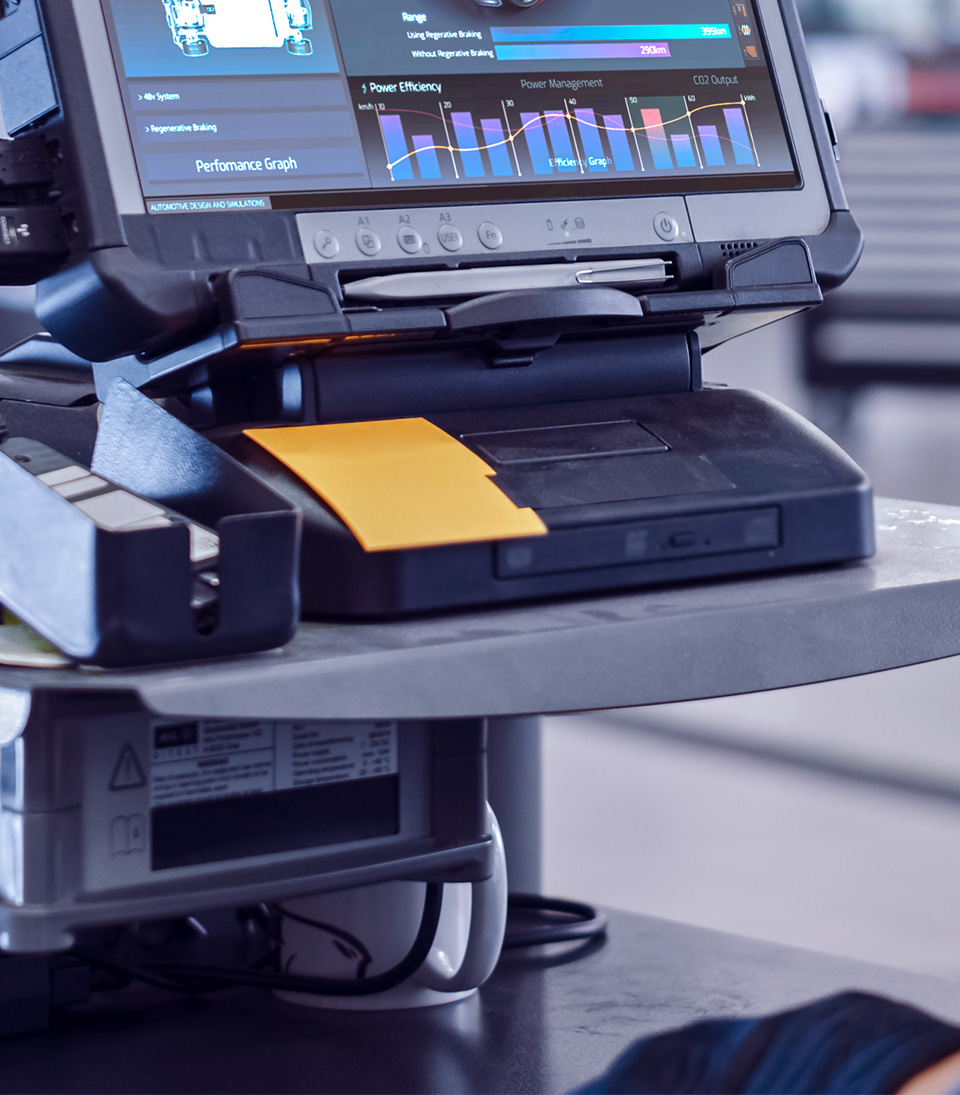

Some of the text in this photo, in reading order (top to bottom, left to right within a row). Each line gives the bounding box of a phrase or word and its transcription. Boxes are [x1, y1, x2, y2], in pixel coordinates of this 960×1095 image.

[401, 12, 427, 24] Range
[406, 31, 426, 40] Using
[458, 30, 482, 40] Braking
[700, 26, 727, 36] 395km
[411, 50, 437, 58] Without
[470, 49, 494, 58] Braking
[640, 45, 667, 55] 290km
[520, 78, 604, 91] Power Management
[711, 74, 739, 86] Output
[369, 81, 442, 94] Power Efficiency
[156, 92, 180, 101] System
[150, 123, 217, 134] Regenerative Braking
[195, 156, 298, 173] Perfomance Graph
[588, 156, 613, 168] Graph
[150, 200, 265, 211] AUTOMOTIVE DESIGN AND SIMULATIONS
[358, 217, 370, 226] A1
[398, 214, 412, 224] A2
[440, 212, 452, 222] A3
[441, 232, 458, 243] USER
[485, 231, 497, 239] Fn
